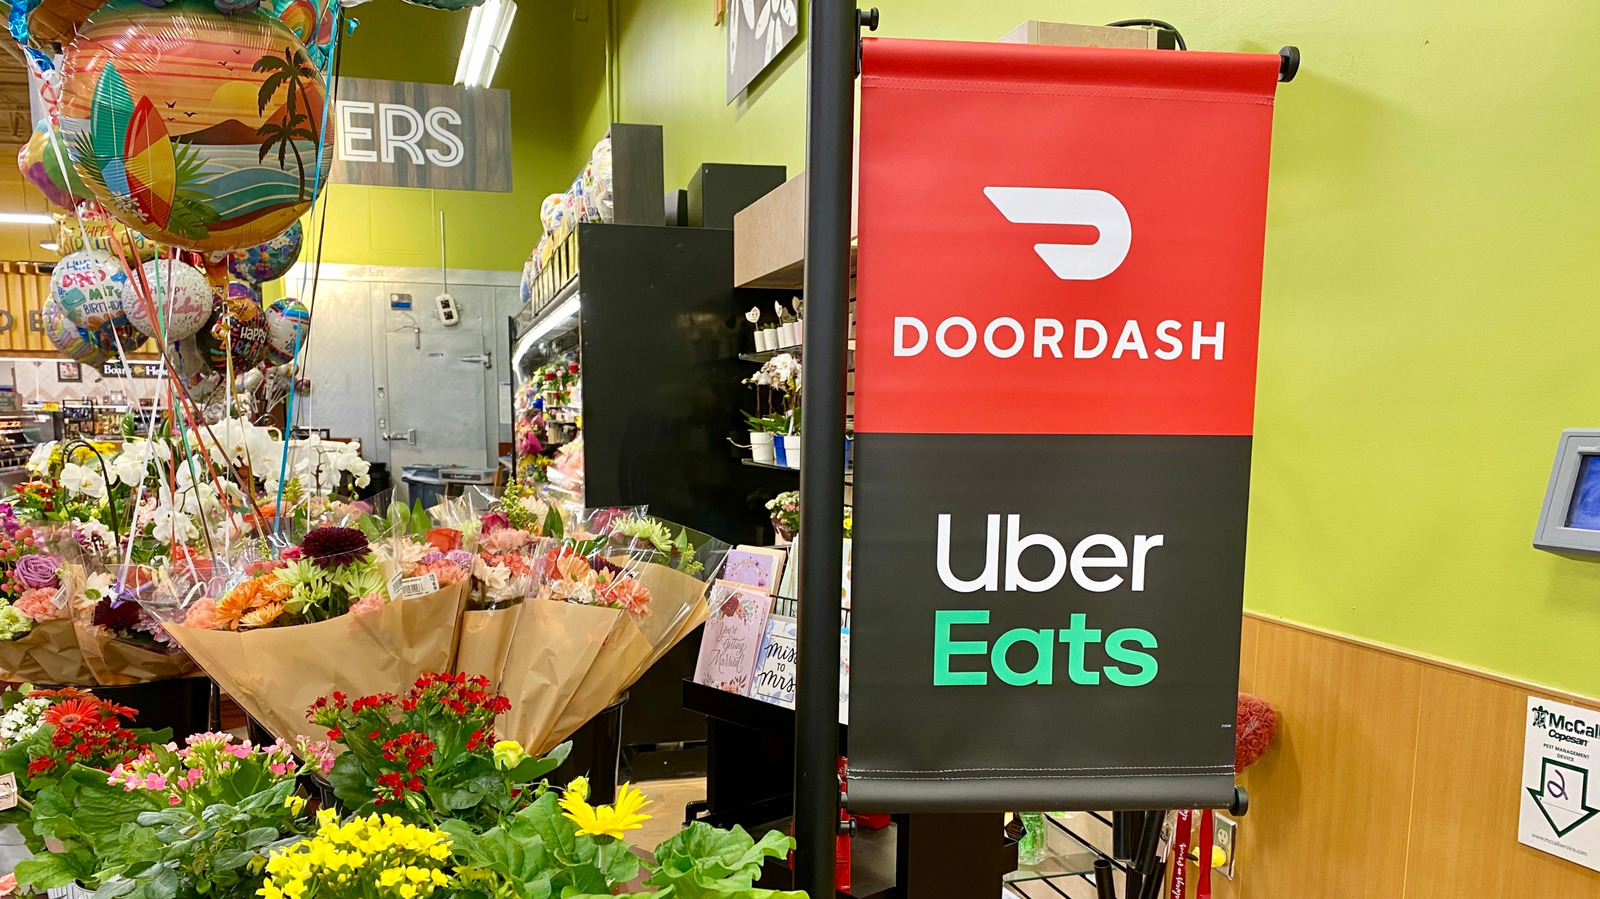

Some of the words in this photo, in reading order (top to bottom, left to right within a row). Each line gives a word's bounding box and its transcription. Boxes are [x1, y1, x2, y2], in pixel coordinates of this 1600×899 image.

[332, 99, 465, 168] ERS
[83, 300, 123, 314] BIRTHD
[893, 315, 1226, 360] DOORDASH
[103, 364, 132, 375] Boar
[936, 513, 1164, 593] Uber
[933, 610, 1158, 687] Eats
[1548, 729, 1588, 747] Copesan
[1555, 746, 1590, 760] MANAGEMENT
[1556, 753, 1575, 762] DEVICE
[1547, 769, 1569, 801] 2
